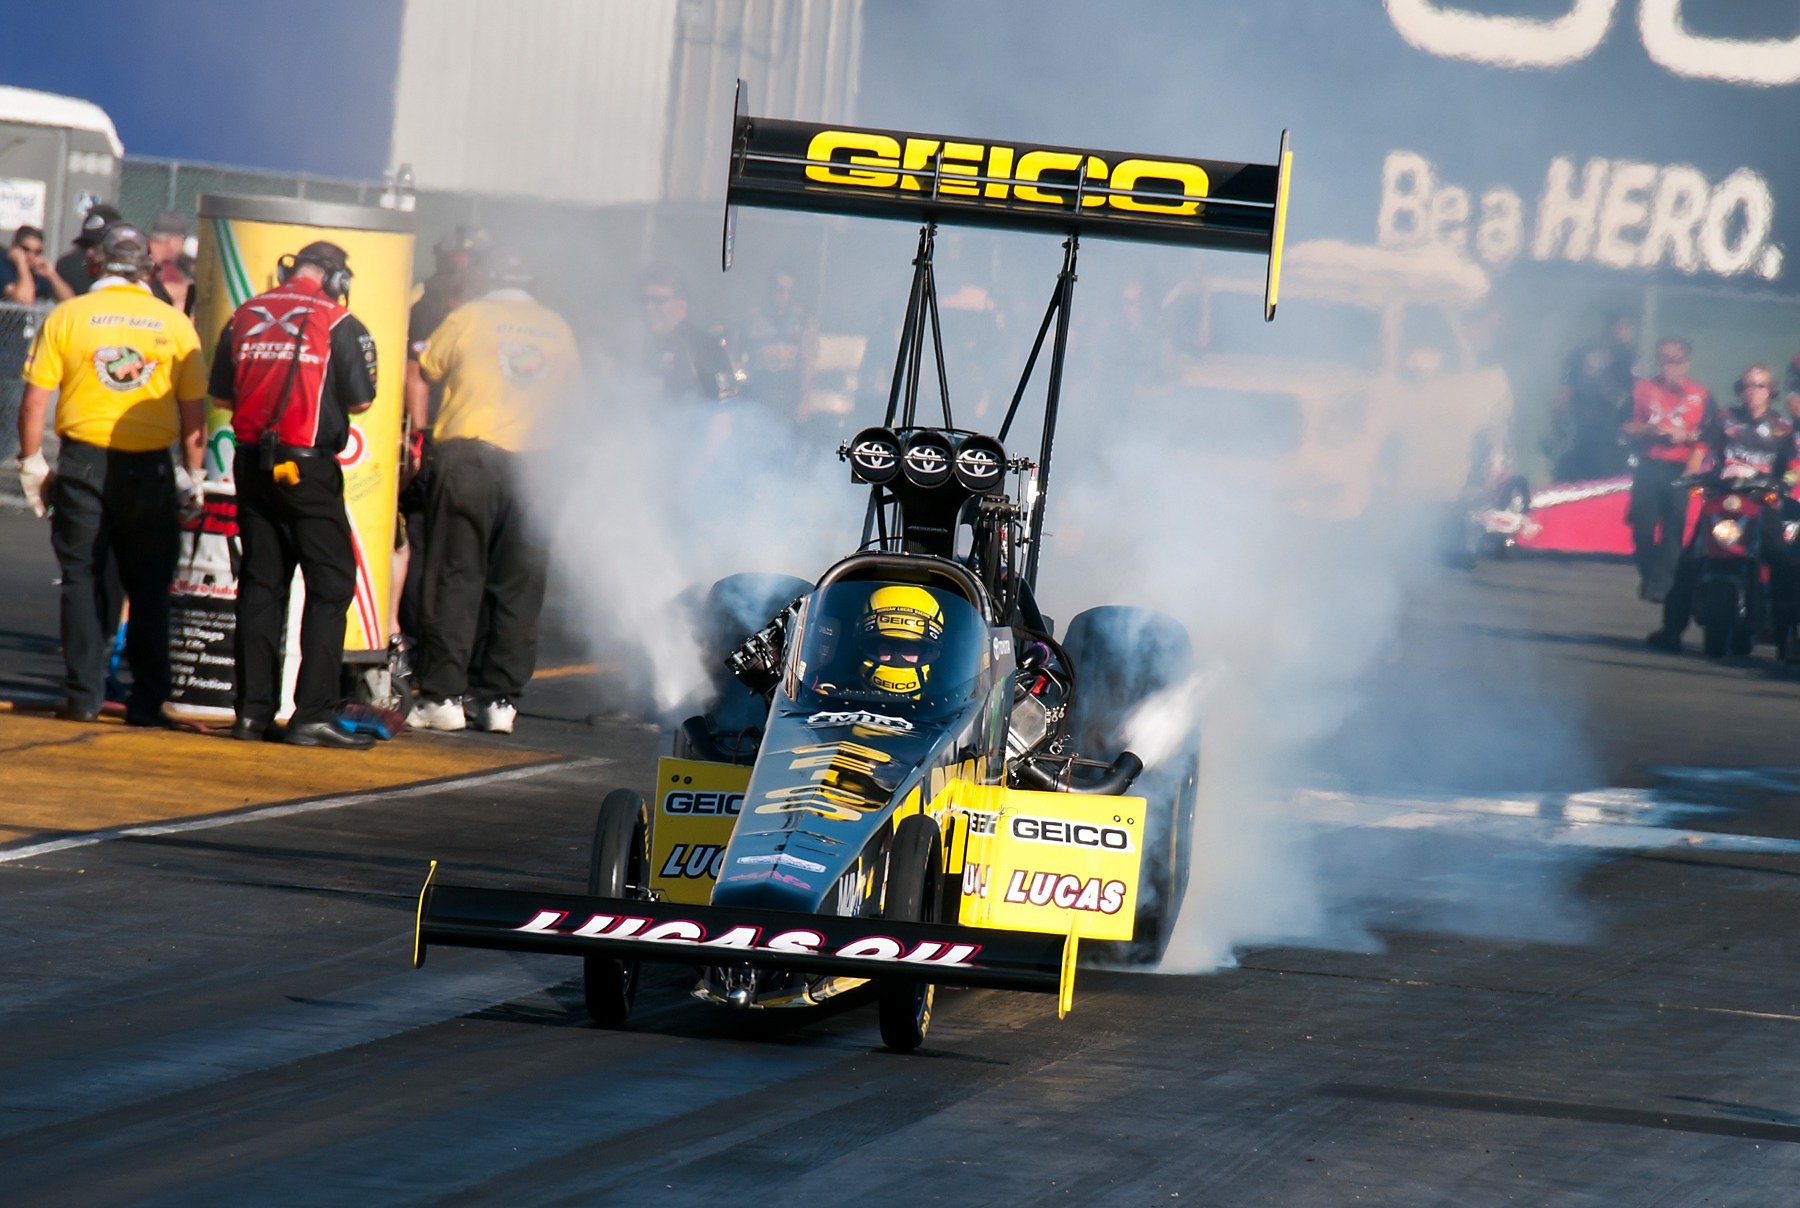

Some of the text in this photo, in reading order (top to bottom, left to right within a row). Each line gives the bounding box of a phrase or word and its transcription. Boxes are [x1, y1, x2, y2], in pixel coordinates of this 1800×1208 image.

[805, 130, 1209, 216] GEICO
[1378, 149, 1785, 280] Be a HERO.
[879, 615, 926, 628] GEICO
[872, 676, 917, 691] GEICO
[1012, 817, 1128, 850] GEICO
[1003, 868, 1127, 915] LUCAS
